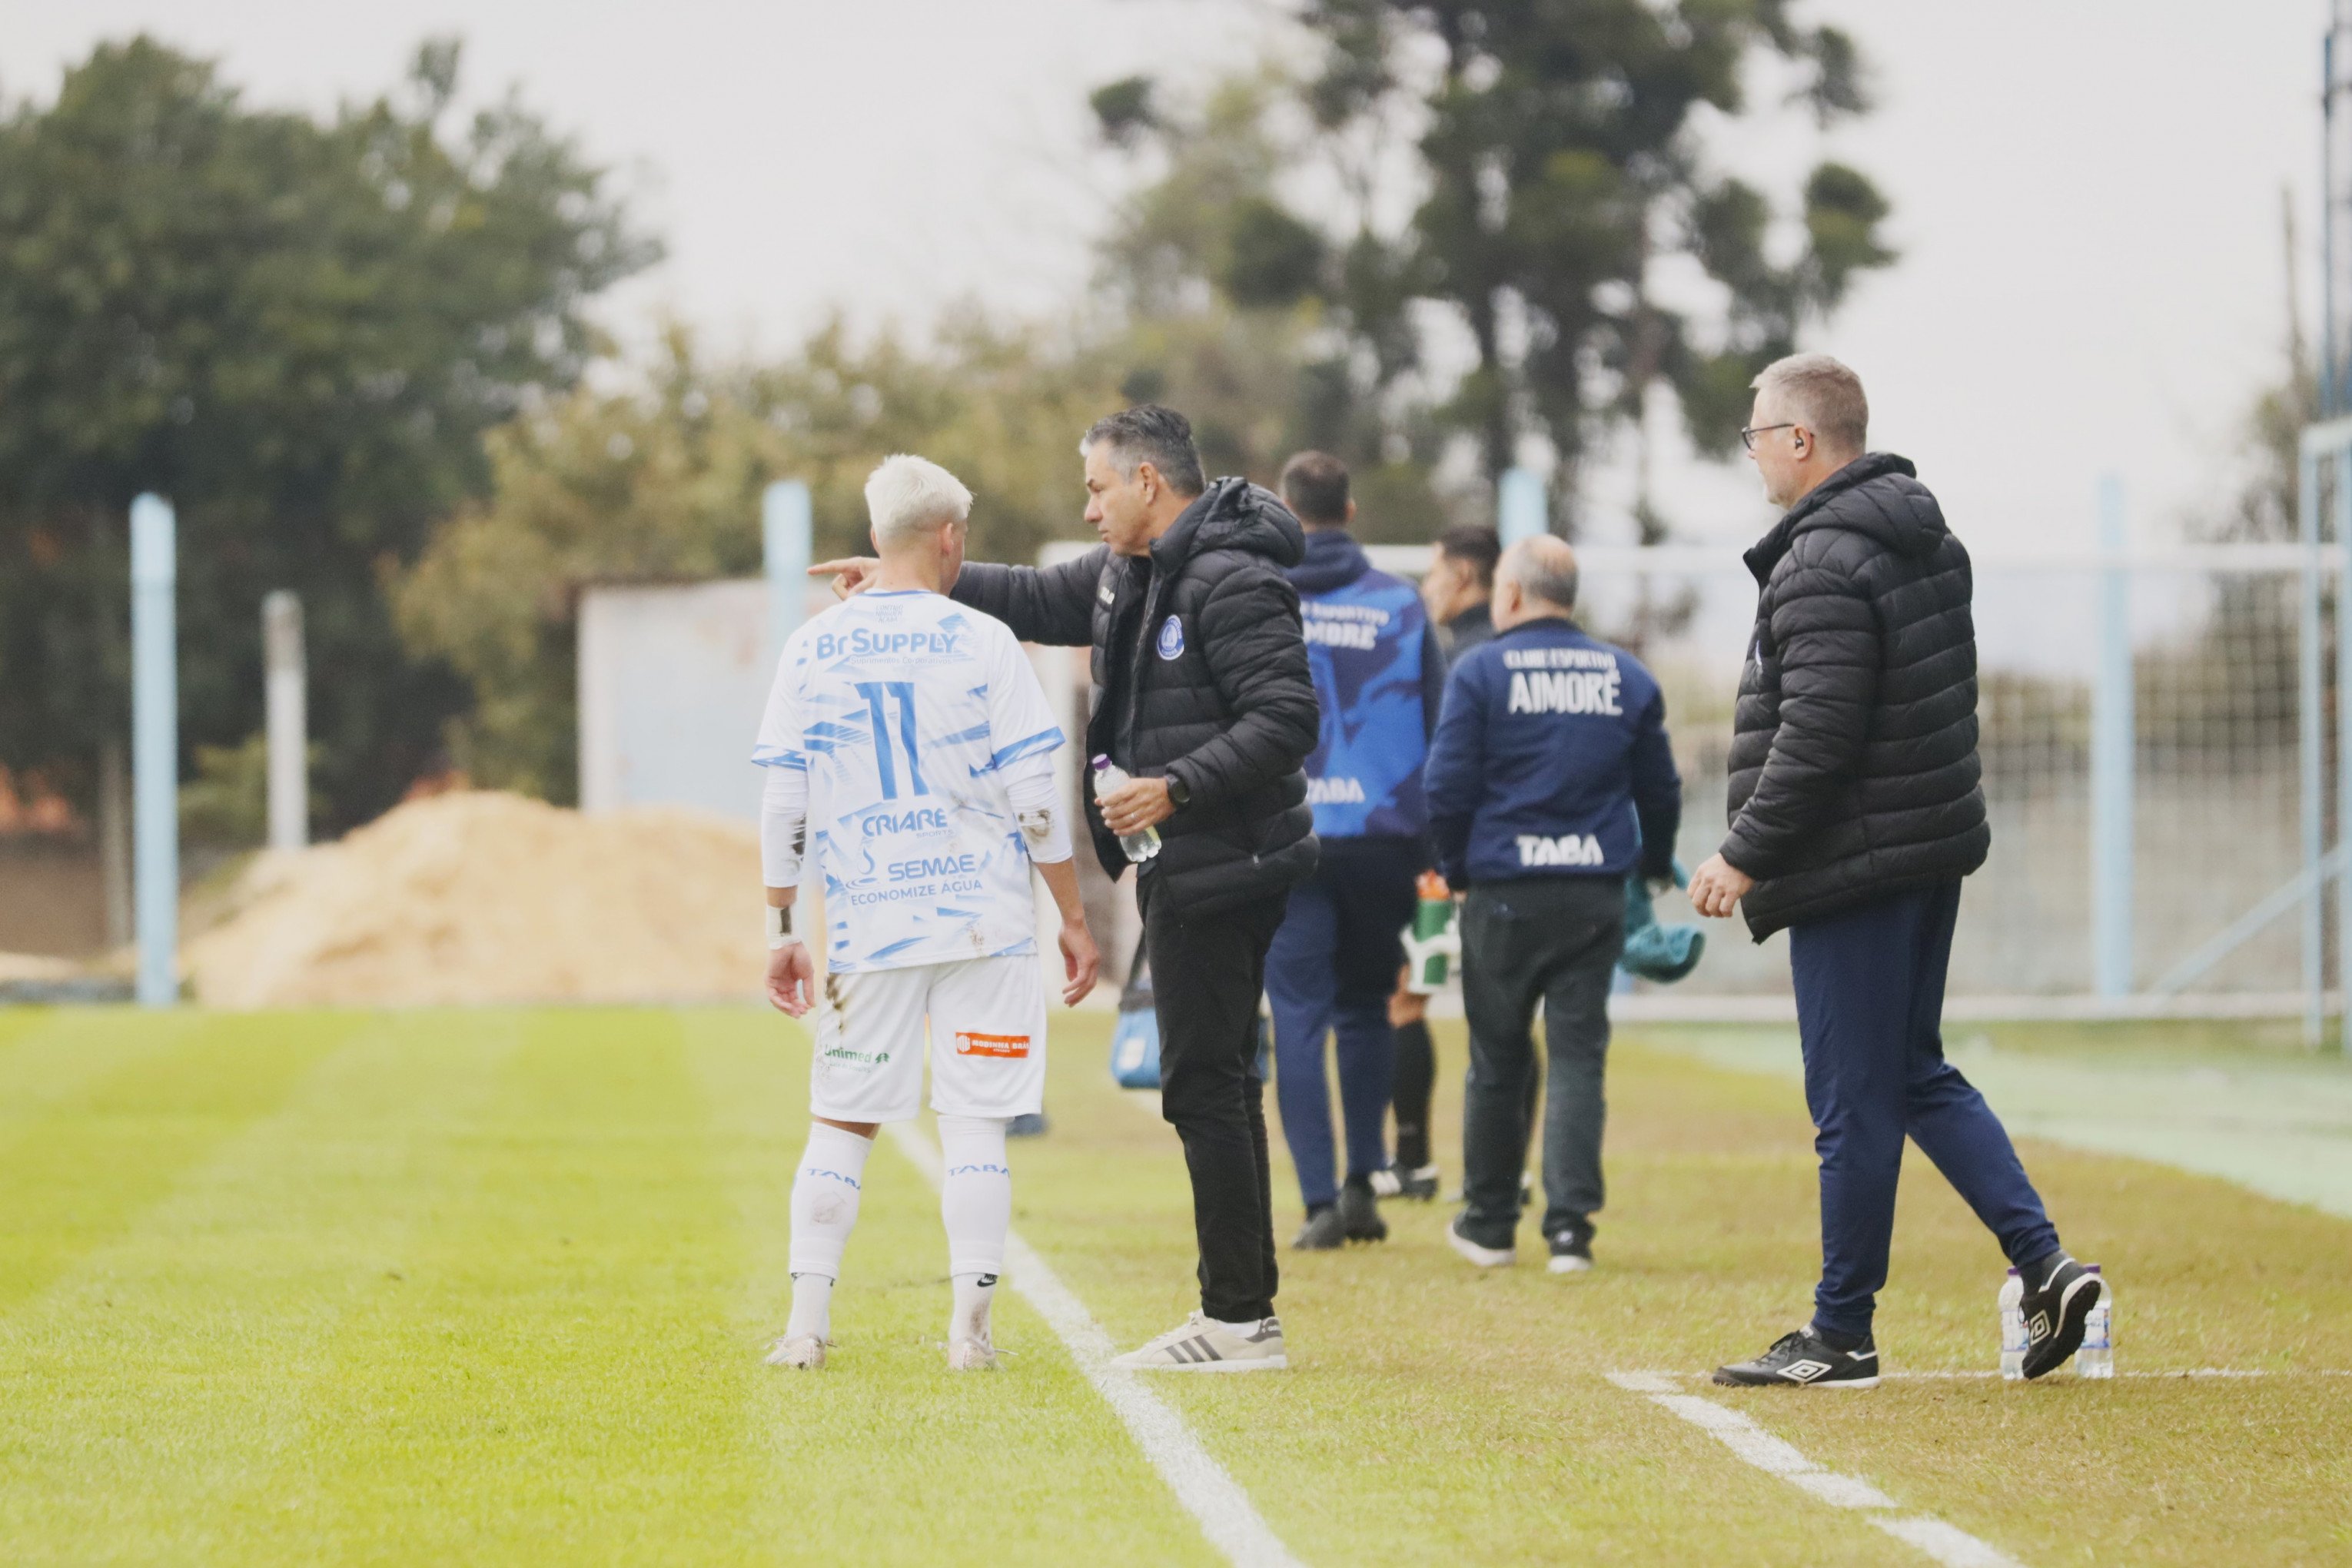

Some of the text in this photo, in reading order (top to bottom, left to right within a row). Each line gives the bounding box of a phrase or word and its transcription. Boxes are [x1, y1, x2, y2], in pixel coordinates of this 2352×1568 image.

[854, 681, 929, 800] 11
[1308, 777, 1366, 804] ABA
[862, 808, 948, 837] CRIARE
[1516, 834, 1604, 866] TABA
[888, 854, 976, 882] SEMAE
[851, 879, 983, 906] ECONOMIZE ÁGUA
[825, 1044, 873, 1063] Unimed
